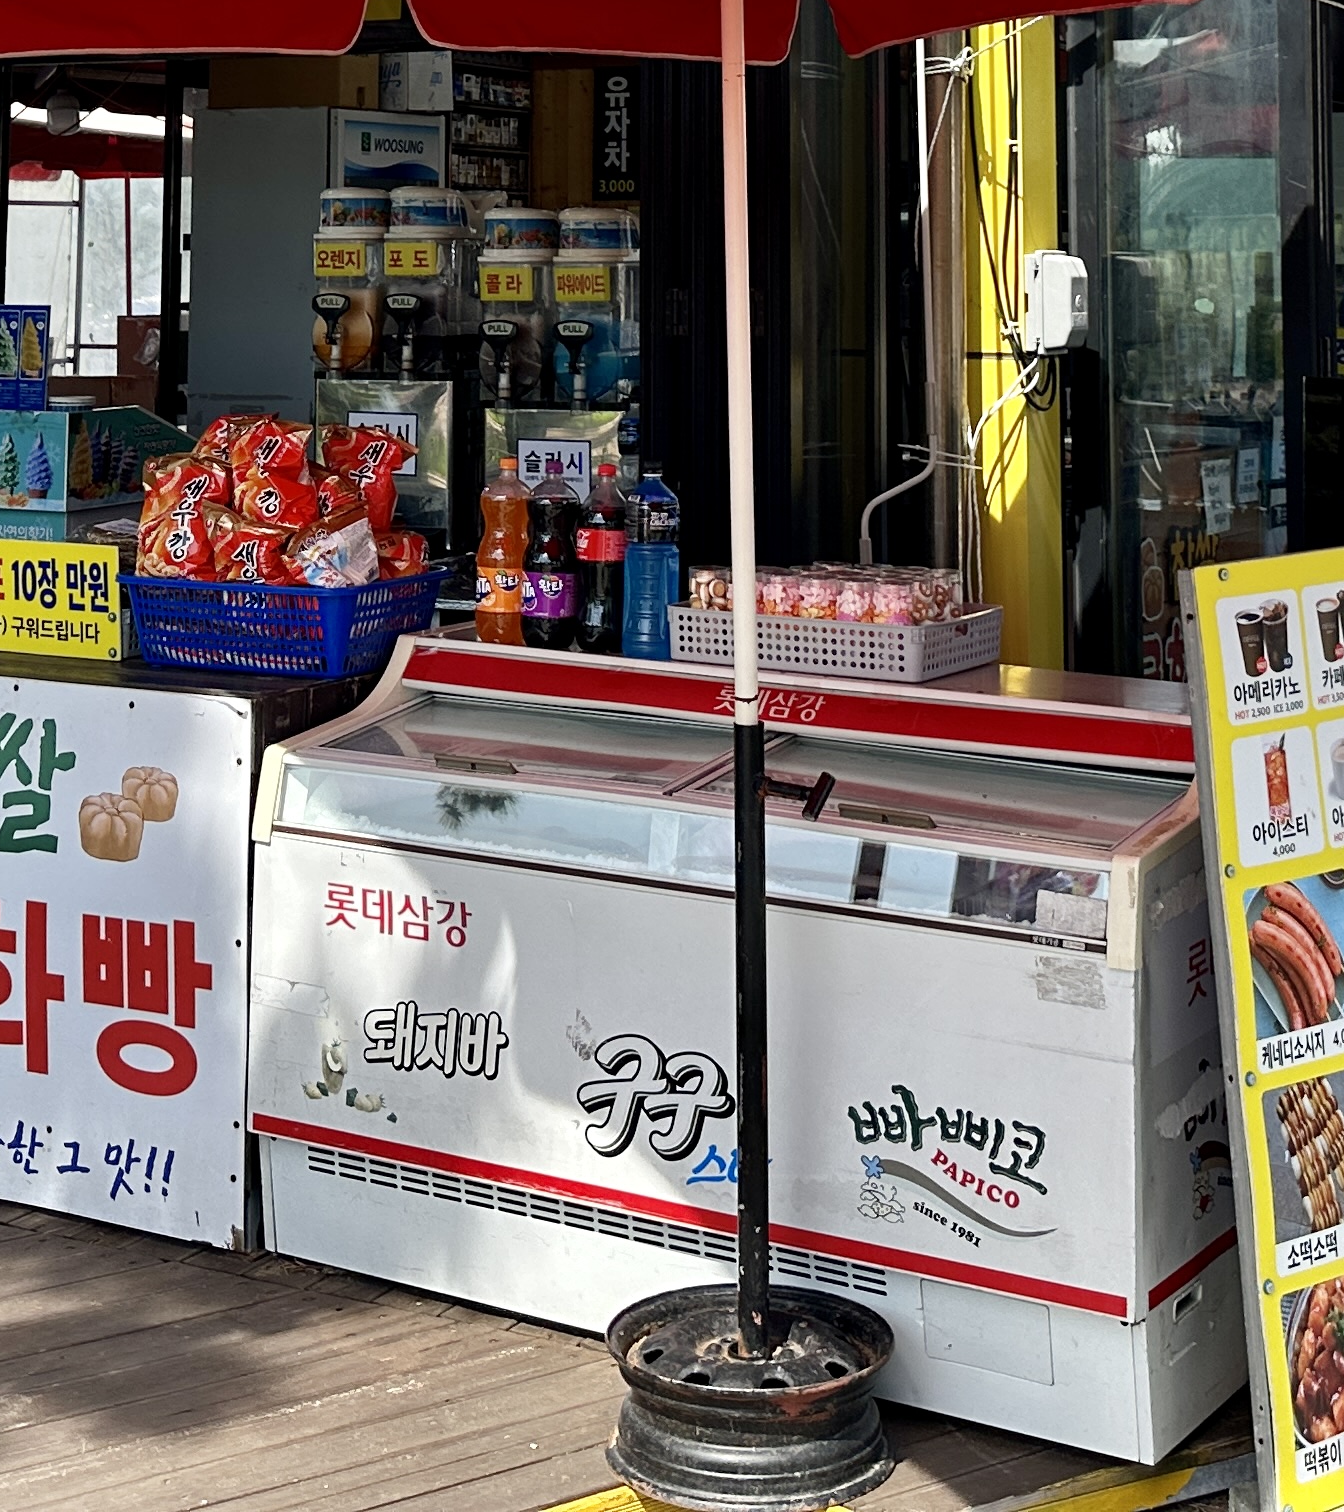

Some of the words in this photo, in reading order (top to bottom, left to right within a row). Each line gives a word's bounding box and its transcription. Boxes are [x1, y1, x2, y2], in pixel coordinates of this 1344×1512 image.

[604, 76, 631, 173] 유자차
[374, 139, 424, 155] WOOSUNG
[599, 179, 635, 193] 3,000
[316, 248, 362, 270] 오렌지
[320, 297, 341, 308] PULL
[391, 297, 412, 308] PULL
[487, 323, 509, 335] PULL
[562, 324, 584, 335] PULL
[11, 559, 59, 609] 10장
[66, 558, 110, 613] 만원
[494, 574, 519, 588] 환타
[538, 578, 564, 592] 환타
[11, 617, 100, 645] 구워드립니다
[1233, 675, 1301, 705] 아메리카노
[1251, 705, 1271, 719] 2,500
[1252, 812, 1310, 845] 아이스티
[1272, 842, 1296, 857] 4,000
[324, 882, 472, 948] 롯데삼강
[363, 1000, 509, 1081] 돼지바
[1261, 1028, 1326, 1069] 케네디소시지
[847, 1084, 1048, 1195] 빠삐코
[56, 1140, 91, 1175] 그
[104, 1139, 177, 1202] 맛!!
[931, 1148, 1021, 1210] PAPICO
[913, 1200, 948, 1226] since
[951, 1221, 982, 1249] 1981
[1286, 1230, 1339, 1270] 소떡소떡
[1304, 1439, 1343, 1476] 떡볶이
